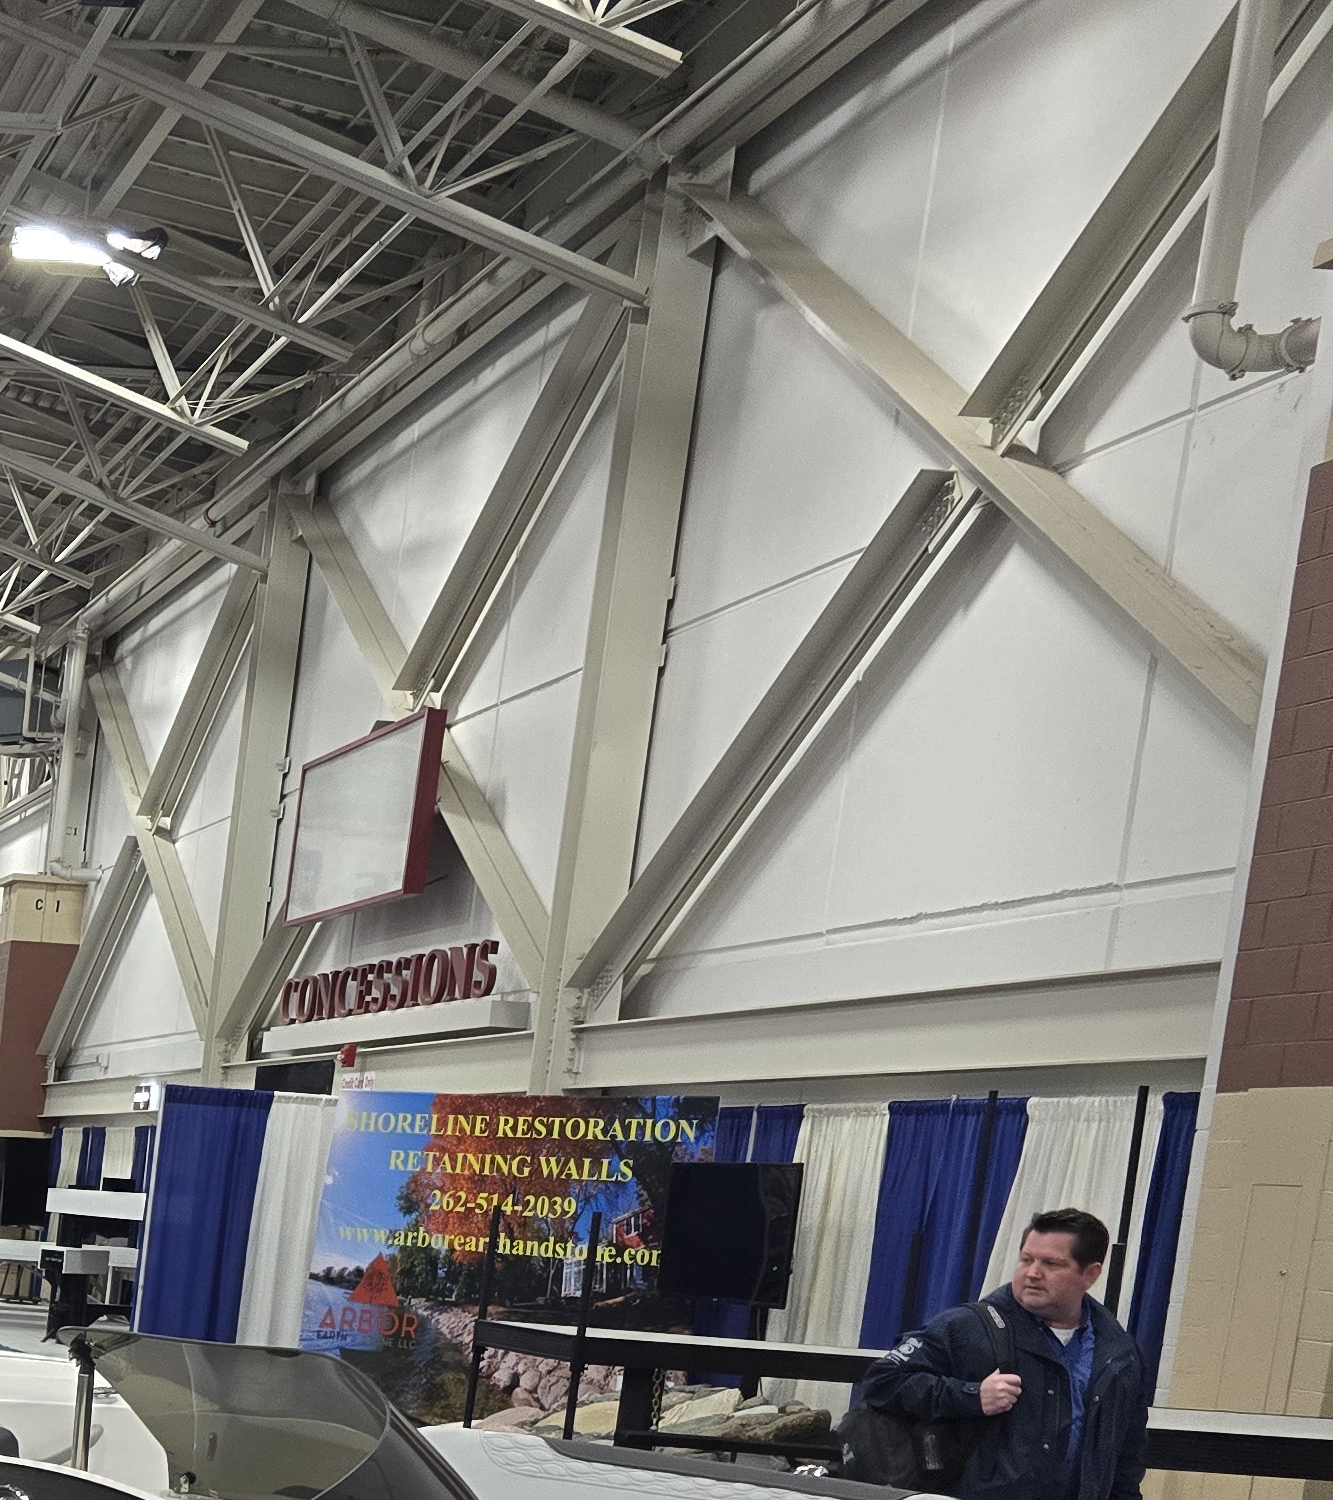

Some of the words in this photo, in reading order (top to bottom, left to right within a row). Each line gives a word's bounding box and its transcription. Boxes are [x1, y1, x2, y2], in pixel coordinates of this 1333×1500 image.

[35, 898, 44, 911] C
[280, 939, 500, 1026] CONCESSIONS
[346, 1110, 490, 1138] SHORELINE
[496, 1114, 699, 1144] RESTORATION
[388, 1149, 532, 1178] RETAINING
[538, 1155, 634, 1183] WALLS
[318, 1305, 419, 1339] ARBOR
